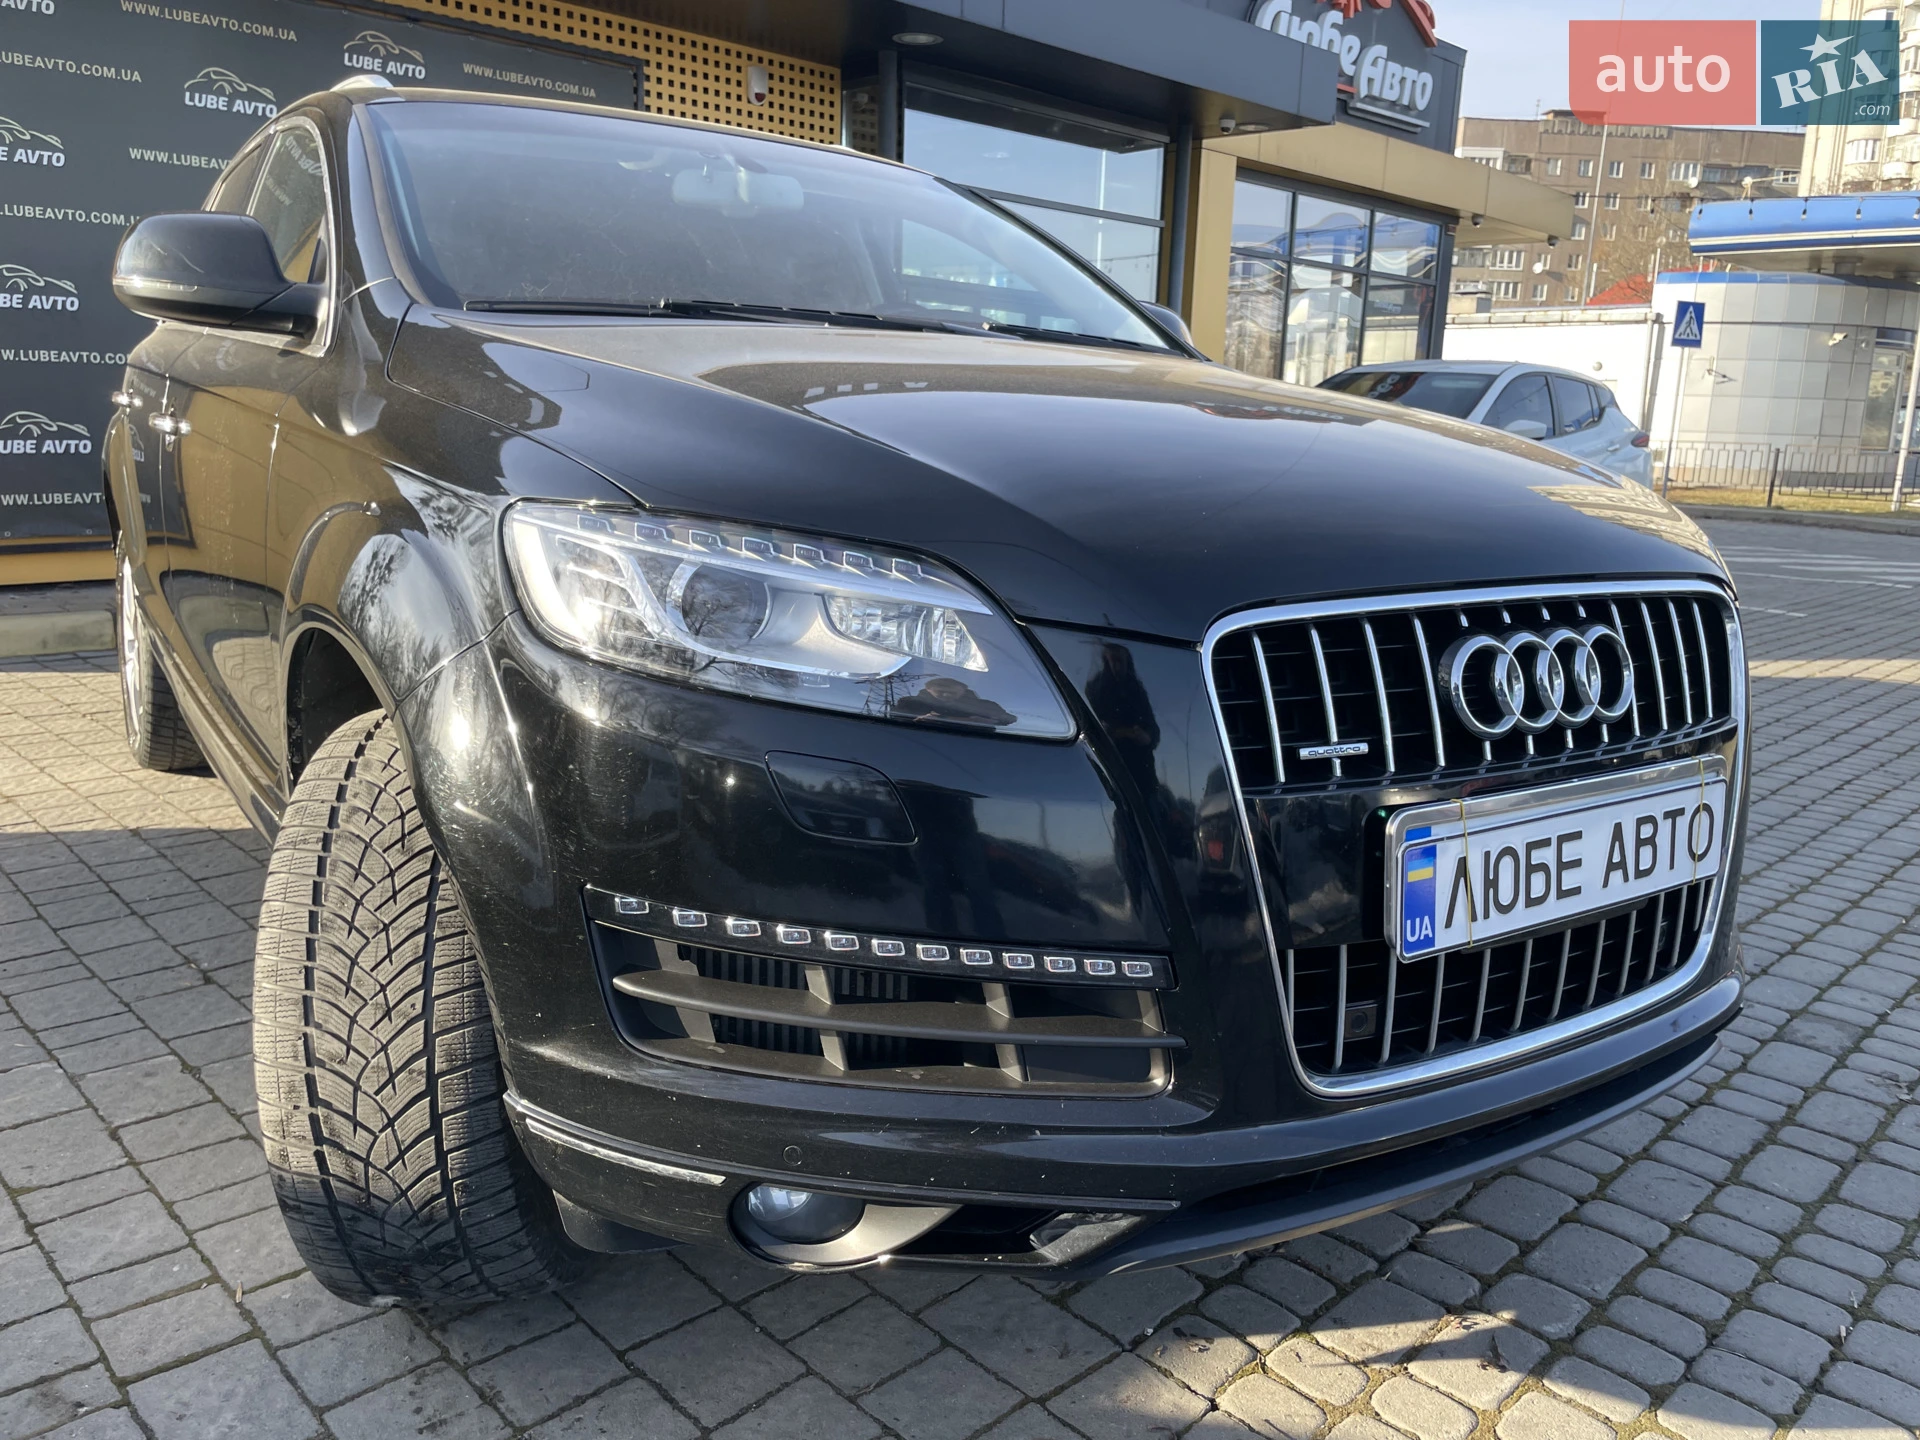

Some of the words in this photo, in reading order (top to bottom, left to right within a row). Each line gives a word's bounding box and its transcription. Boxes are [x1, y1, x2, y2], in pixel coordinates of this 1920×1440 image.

[120, 0, 298, 42] WWW.LUBEAVTO.COM.UA
[0, 51, 142, 82] UBEAVTO.COM.UA
[344, 52, 383, 72] LUBE
[386, 61, 426, 80] AVTO
[463, 62, 597, 98] WWW.LUBEAVTO.COM.UA
[184, 91, 228, 111] LUBE
[232, 98, 278, 118] AVTO
[13, 148, 65, 167] AVTO
[28, 295, 79, 312] AVTO
[1, 349, 130, 365] W.LUBEAVTO.CO
[0, 440, 37, 454] UBE
[41, 440, 92, 454] AVTO
[0, 492, 105, 506] WW.LUBEAVT
[1308, 745, 1361, 757] quattro
[1444, 829, 1583, 930] ЛЮБЕ
[1602, 801, 1715, 889] АВТО
[1406, 915, 1433, 943] UA
